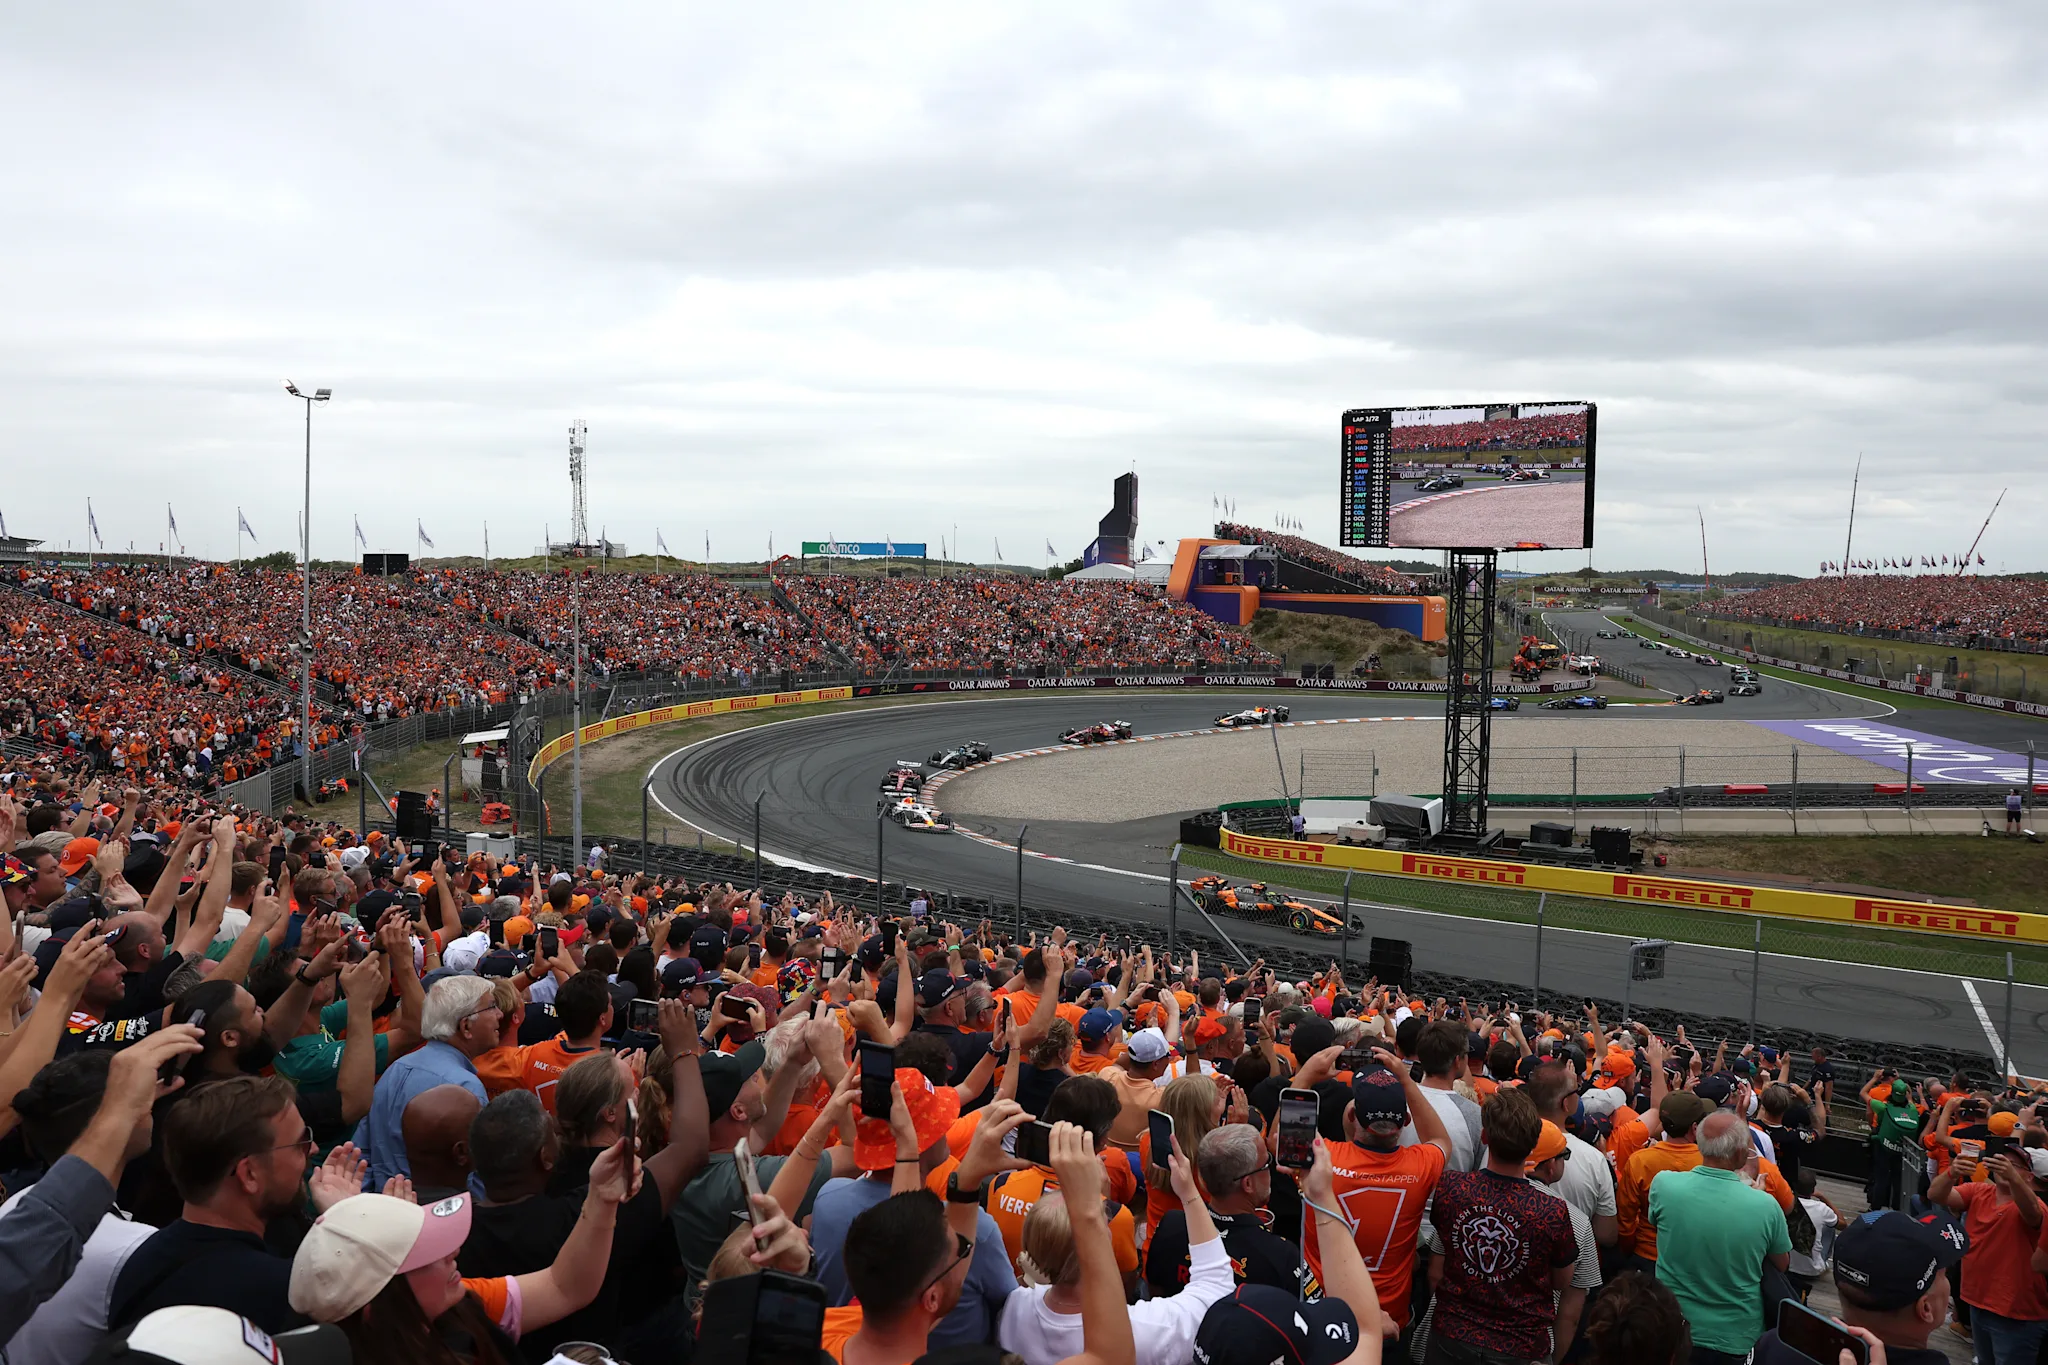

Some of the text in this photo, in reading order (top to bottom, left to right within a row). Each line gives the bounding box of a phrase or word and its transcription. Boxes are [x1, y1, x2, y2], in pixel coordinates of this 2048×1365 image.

[949, 680, 1010, 690] QATAR AIRWAYS
[1027, 678, 1095, 688] QATAR AIRWAYS
[1115, 677, 1185, 686] QATAR AIRWAYS
[1204, 676, 1276, 686] QATAR AIRWAYS
[1296, 679, 1367, 689] QATAR AIRWAYS
[1388, 682, 1451, 691] QATAR AIRWA
[1553, 683, 1568, 692] QATAR
[818, 688, 844, 699] PIRELLI
[1509, 685, 1540, 693] AIRWAYS
[1924, 686, 1956, 700] QATAR AIRWAYS
[730, 697, 757, 710] PIRELLI
[774, 692, 801, 704] PIRELLI
[1966, 693, 2004, 708] QATAR AIRWAYS
[688, 702, 713, 715] PIRELLI
[2015, 702, 2035, 714] QATAR
[650, 708, 672, 722] PIRELLI
[616, 716, 636, 730] PIRELLI
[586, 724, 604, 740] PIRELLI
[1228, 834, 1324, 862] PIRELLI
[1402, 854, 1526, 884] PIRELLI
[1613, 876, 1754, 908] PIRELLI
[1854, 900, 2020, 936] PIRELLI
[126, 1019, 136, 1040] HRC
[1208, 1210, 1234, 1221] HONDA
[1452, 1209, 1471, 1248] UNLEASH
[1498, 1209, 1520, 1229] LION
[1946, 1224, 1961, 1249] Heineken
[1462, 1242, 1529, 1283] UNLEASH THE LION
